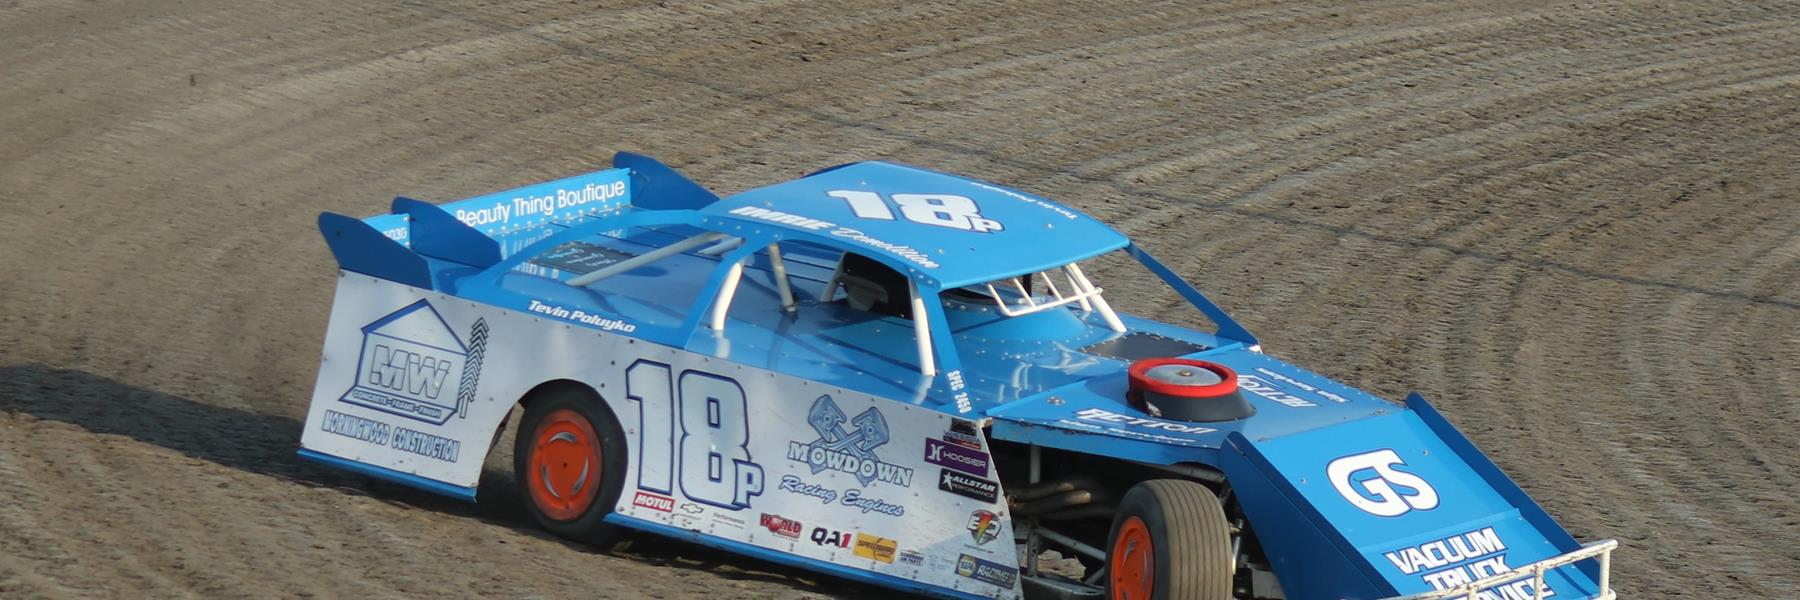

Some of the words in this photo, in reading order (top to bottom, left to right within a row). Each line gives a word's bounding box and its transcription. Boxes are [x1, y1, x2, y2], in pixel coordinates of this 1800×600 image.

[457, 202, 510, 228] Beauty
[513, 194, 554, 218] Thing
[557, 180, 626, 208] Boutique
[528, 300, 570, 319] Tevin
[569, 311, 636, 334] Poluyko
[369, 344, 452, 400] MW
[947, 369, 965, 391] SPEC
[322, 409, 391, 446] MORNINGWOOD
[392, 426, 461, 463] CONSTRUCTION
[786, 440, 915, 488] MOWDOWN
[943, 451, 986, 468] HOOSIER
[634, 495, 674, 511] MOTUL
[778, 474, 838, 505] Racing
[841, 489, 905, 517] Engines
[952, 475, 996, 491] ALLSTAR
[1325, 447, 1441, 518] GS
[810, 526, 852, 549] QA1
[1382, 526, 1508, 576] VACUUM
